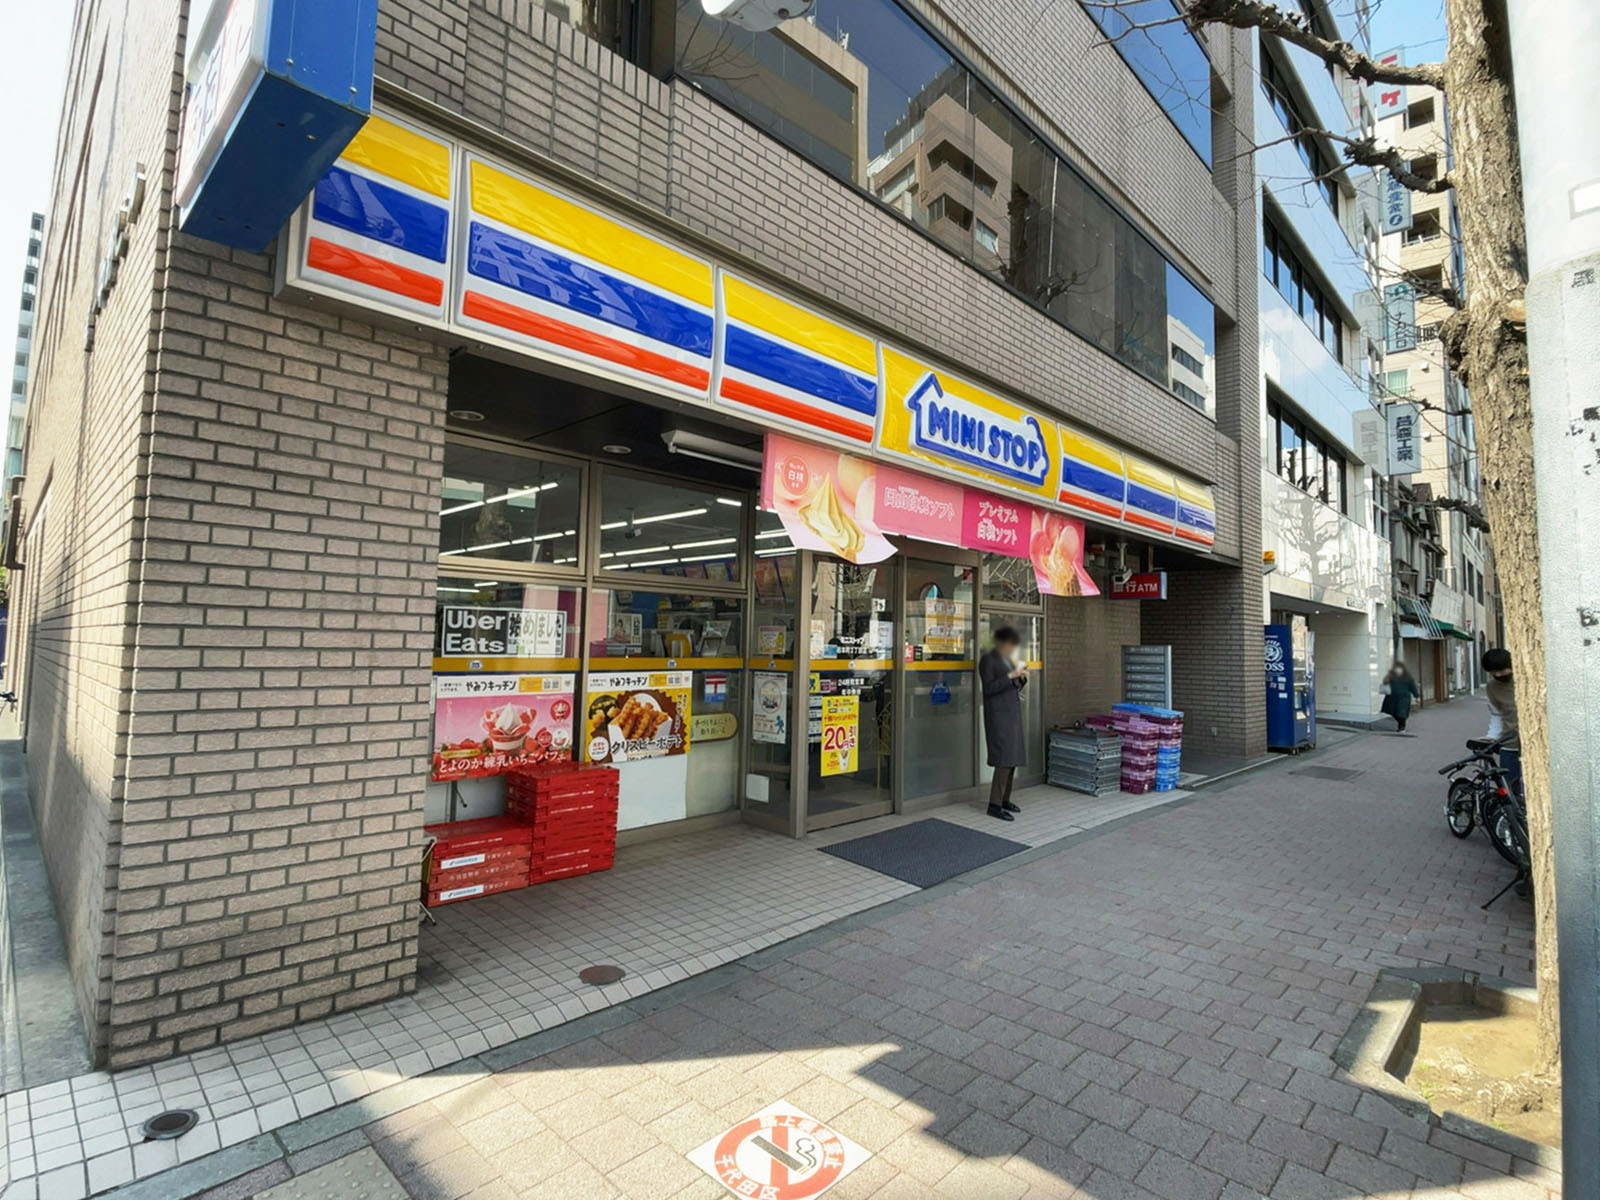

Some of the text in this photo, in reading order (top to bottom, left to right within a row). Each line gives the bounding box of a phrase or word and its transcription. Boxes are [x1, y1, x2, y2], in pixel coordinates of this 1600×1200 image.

[928, 401, 1041, 471] MINI STOP
[978, 501, 1019, 523] プレミアム
[977, 520, 1017, 546] 白桃ソフト
[447, 610, 506, 631] Uber
[446, 633, 505, 653] Eats
[715, 1153, 780, 1200] 千代田区
